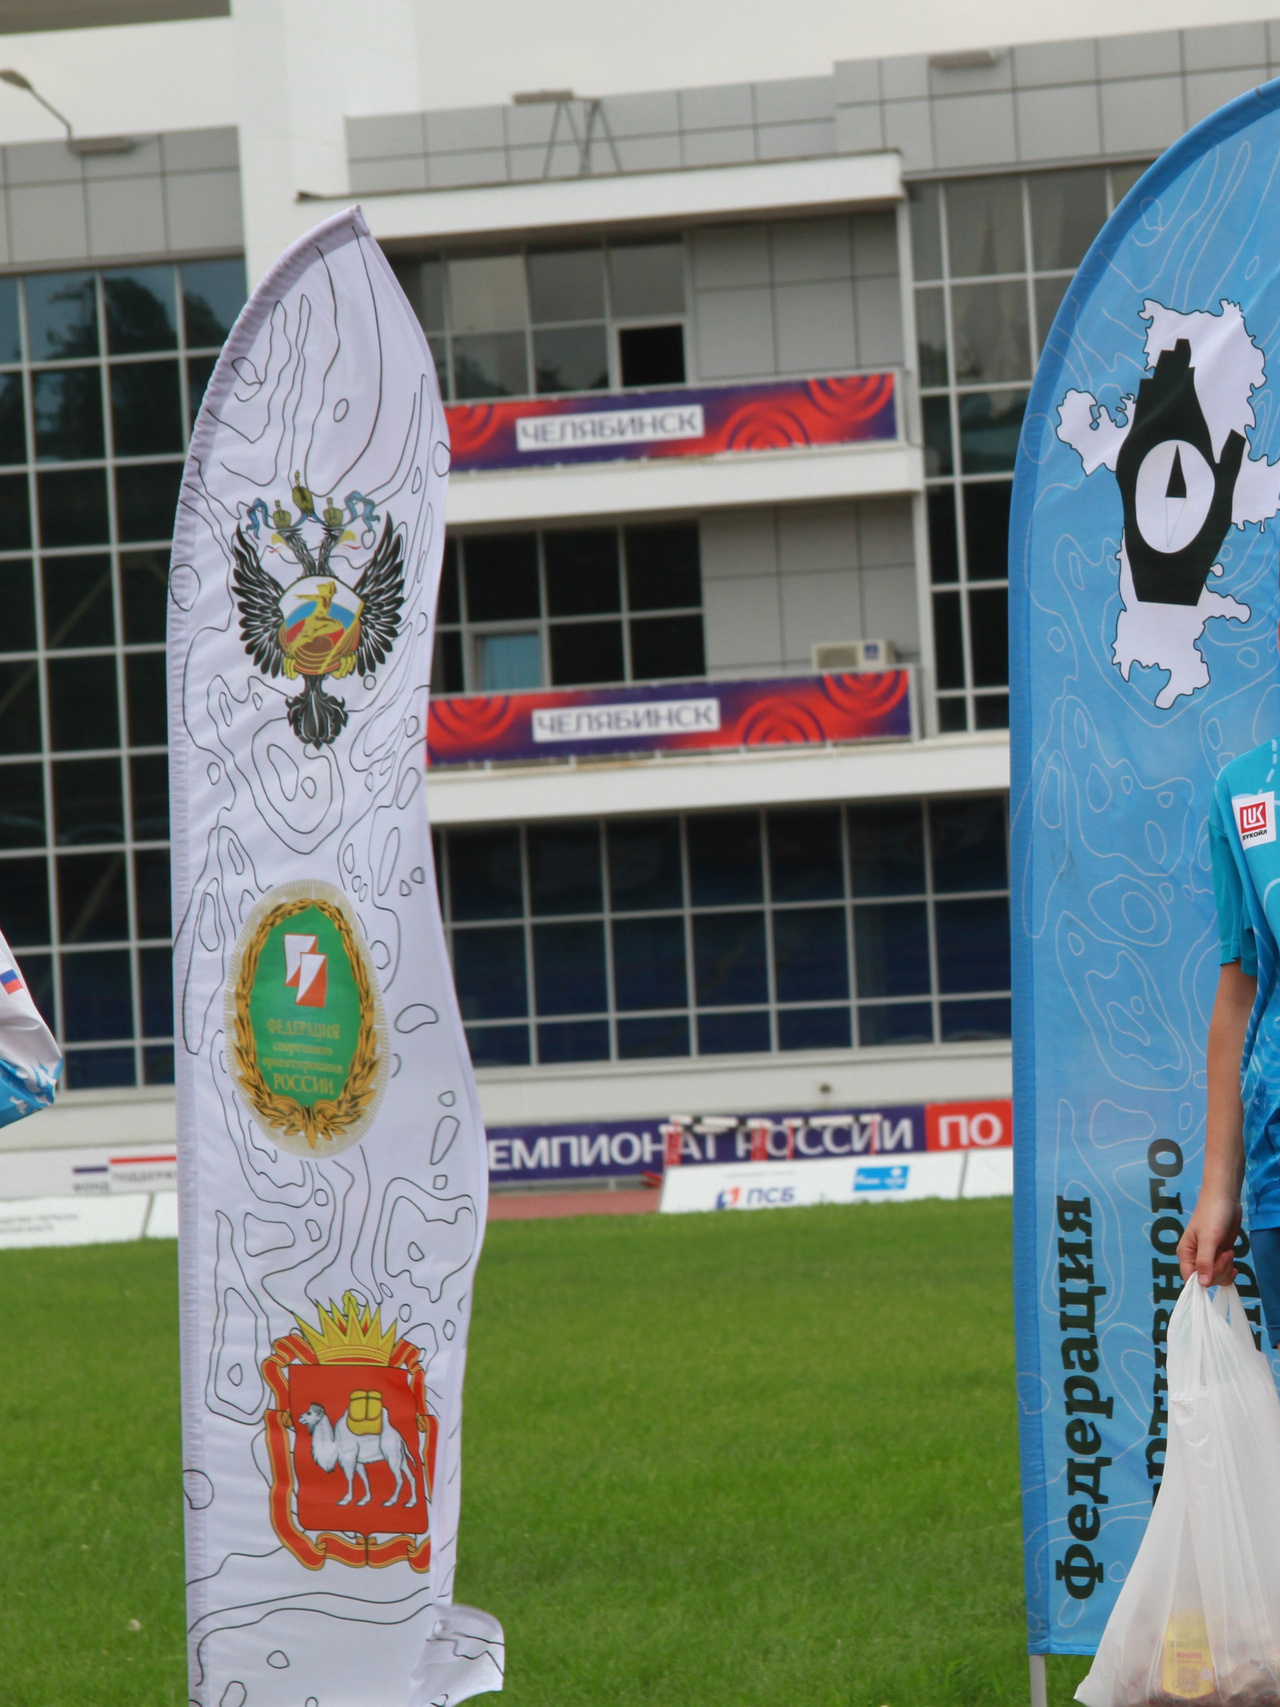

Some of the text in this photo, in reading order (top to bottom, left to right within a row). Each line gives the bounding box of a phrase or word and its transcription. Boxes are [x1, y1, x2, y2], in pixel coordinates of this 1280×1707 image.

[521, 411, 696, 443] ЧЕЛЯБИНСК
[537, 706, 715, 736] ЧЕЛЯБИНСК
[1242, 829, 1267, 841] ЛУКОЙЛ
[273, 1072, 334, 1095] РОССИИ
[939, 1113, 1003, 1148] ПО
[747, 1186, 795, 1203] ПСБ
[1055, 1195, 1114, 1600] Федерация
